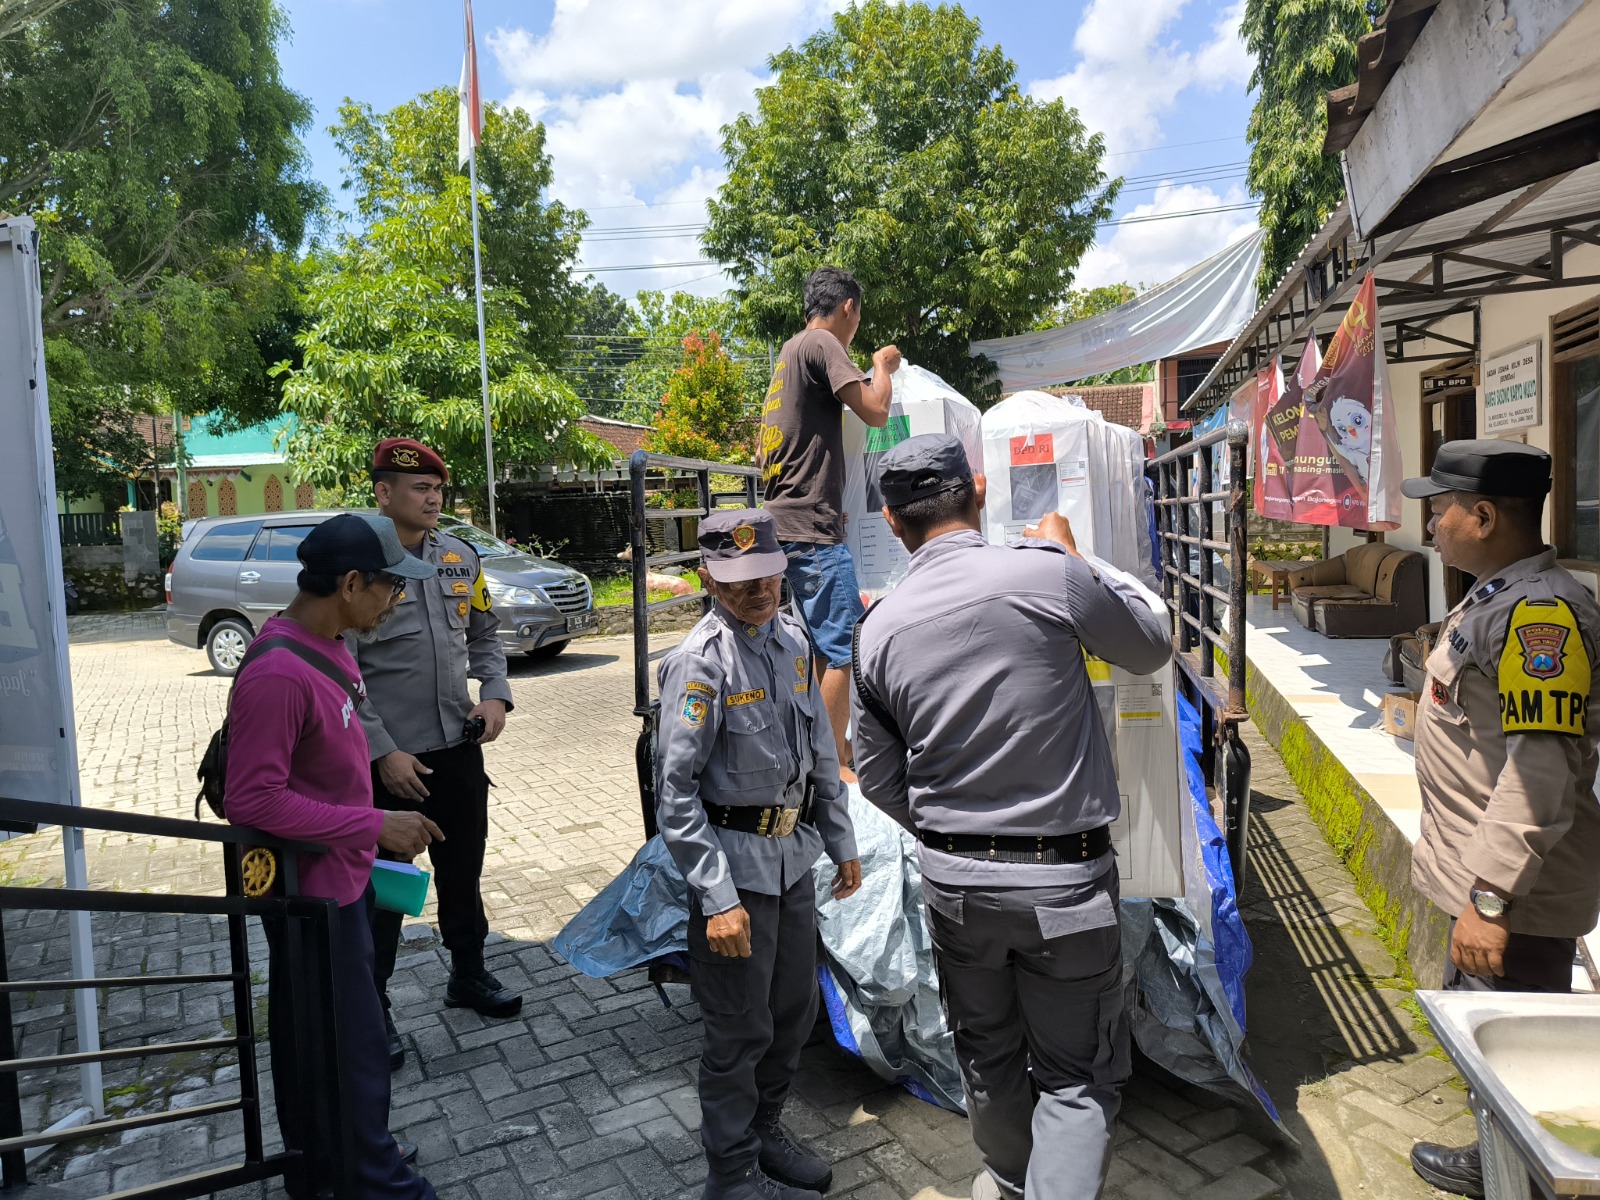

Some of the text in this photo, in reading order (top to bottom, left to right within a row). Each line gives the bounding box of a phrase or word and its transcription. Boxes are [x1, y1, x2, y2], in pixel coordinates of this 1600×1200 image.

[1523, 356, 1533, 366] DESA
[1272, 402, 1305, 427] KELOM
[1280, 424, 1299, 442] PEM
[1014, 444, 1050, 455] DPD RI
[437, 567, 471, 578] POLRI
[730, 691, 761, 703] SUKENO
[1499, 689, 1589, 729] PAM TPS
